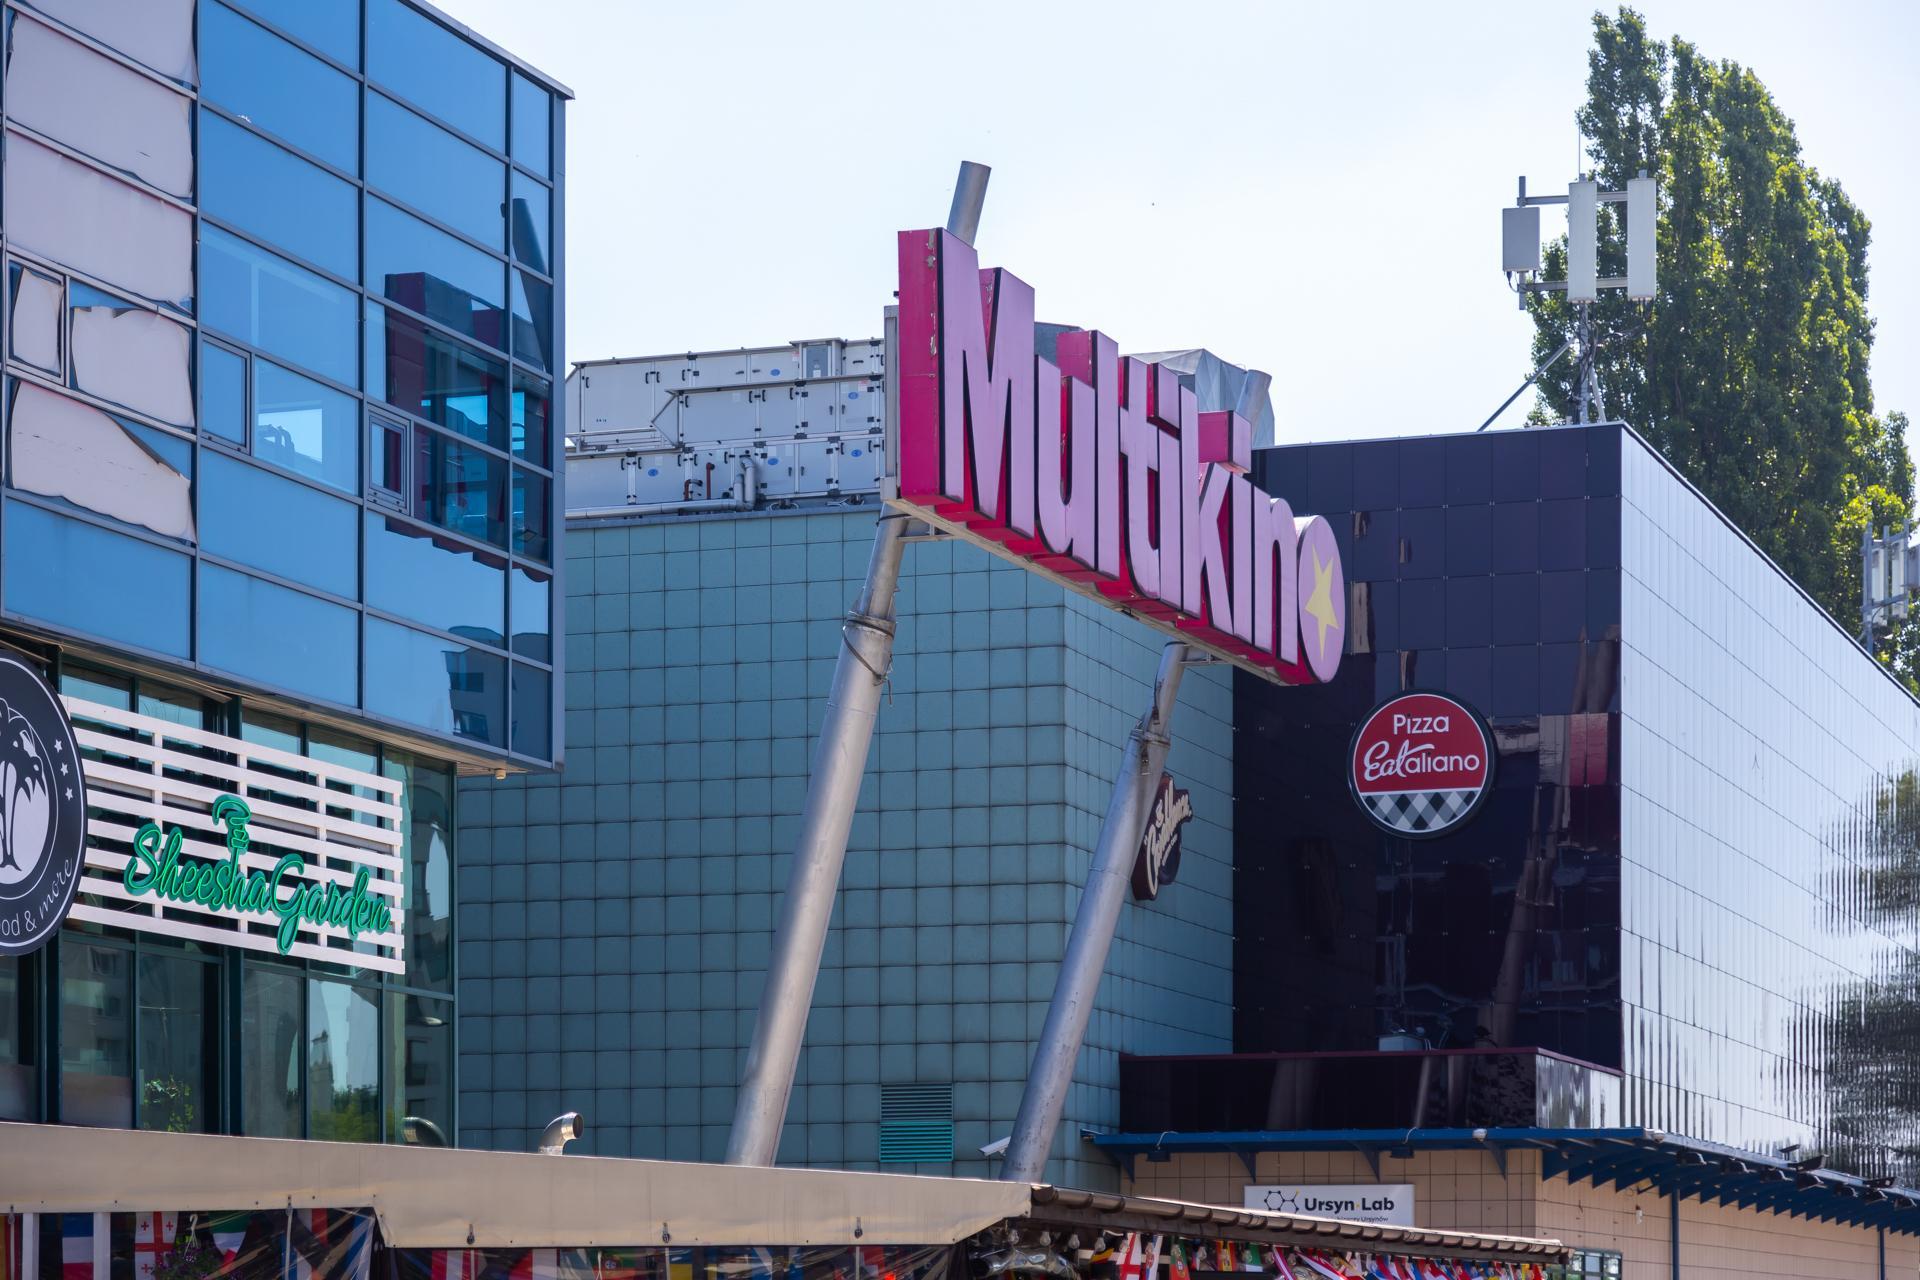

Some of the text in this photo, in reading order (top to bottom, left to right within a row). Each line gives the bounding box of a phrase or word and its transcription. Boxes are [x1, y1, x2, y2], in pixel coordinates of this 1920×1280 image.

[899, 228, 1346, 684] Multikino
[1393, 713, 1450, 735] Pizza
[1363, 738, 1480, 782] Eataliano
[24, 910, 37, 932] &
[39, 857, 73, 920] more
[124, 822, 391, 955] Sheesha Garden
[1304, 1197, 1395, 1214] Ursyn Lab
